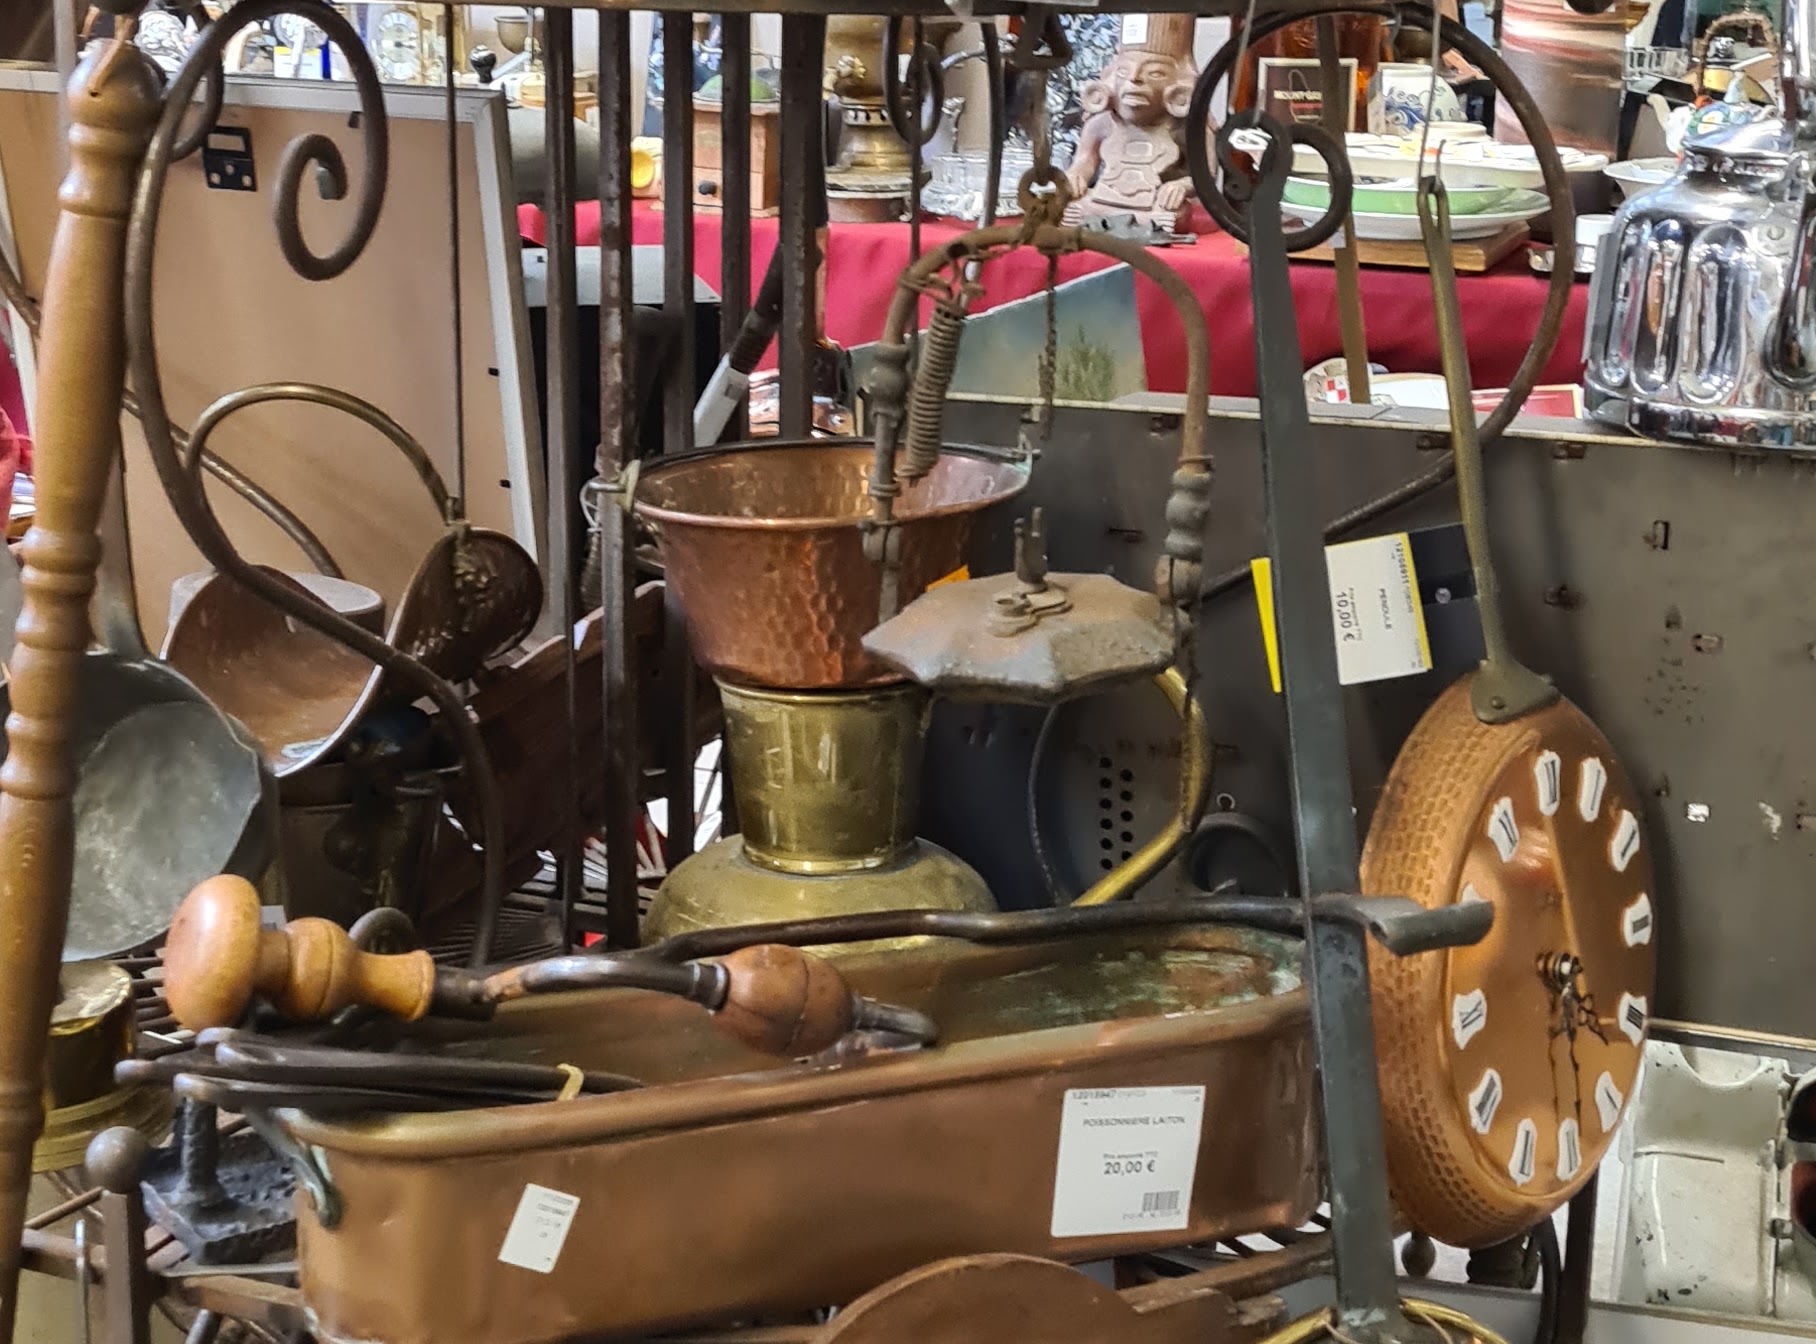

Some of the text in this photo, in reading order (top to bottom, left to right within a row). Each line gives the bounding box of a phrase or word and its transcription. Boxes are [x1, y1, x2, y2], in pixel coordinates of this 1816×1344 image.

[1336, 591, 1356, 642] 10,00 €
[1103, 1160, 1156, 1175] 20,00 €
